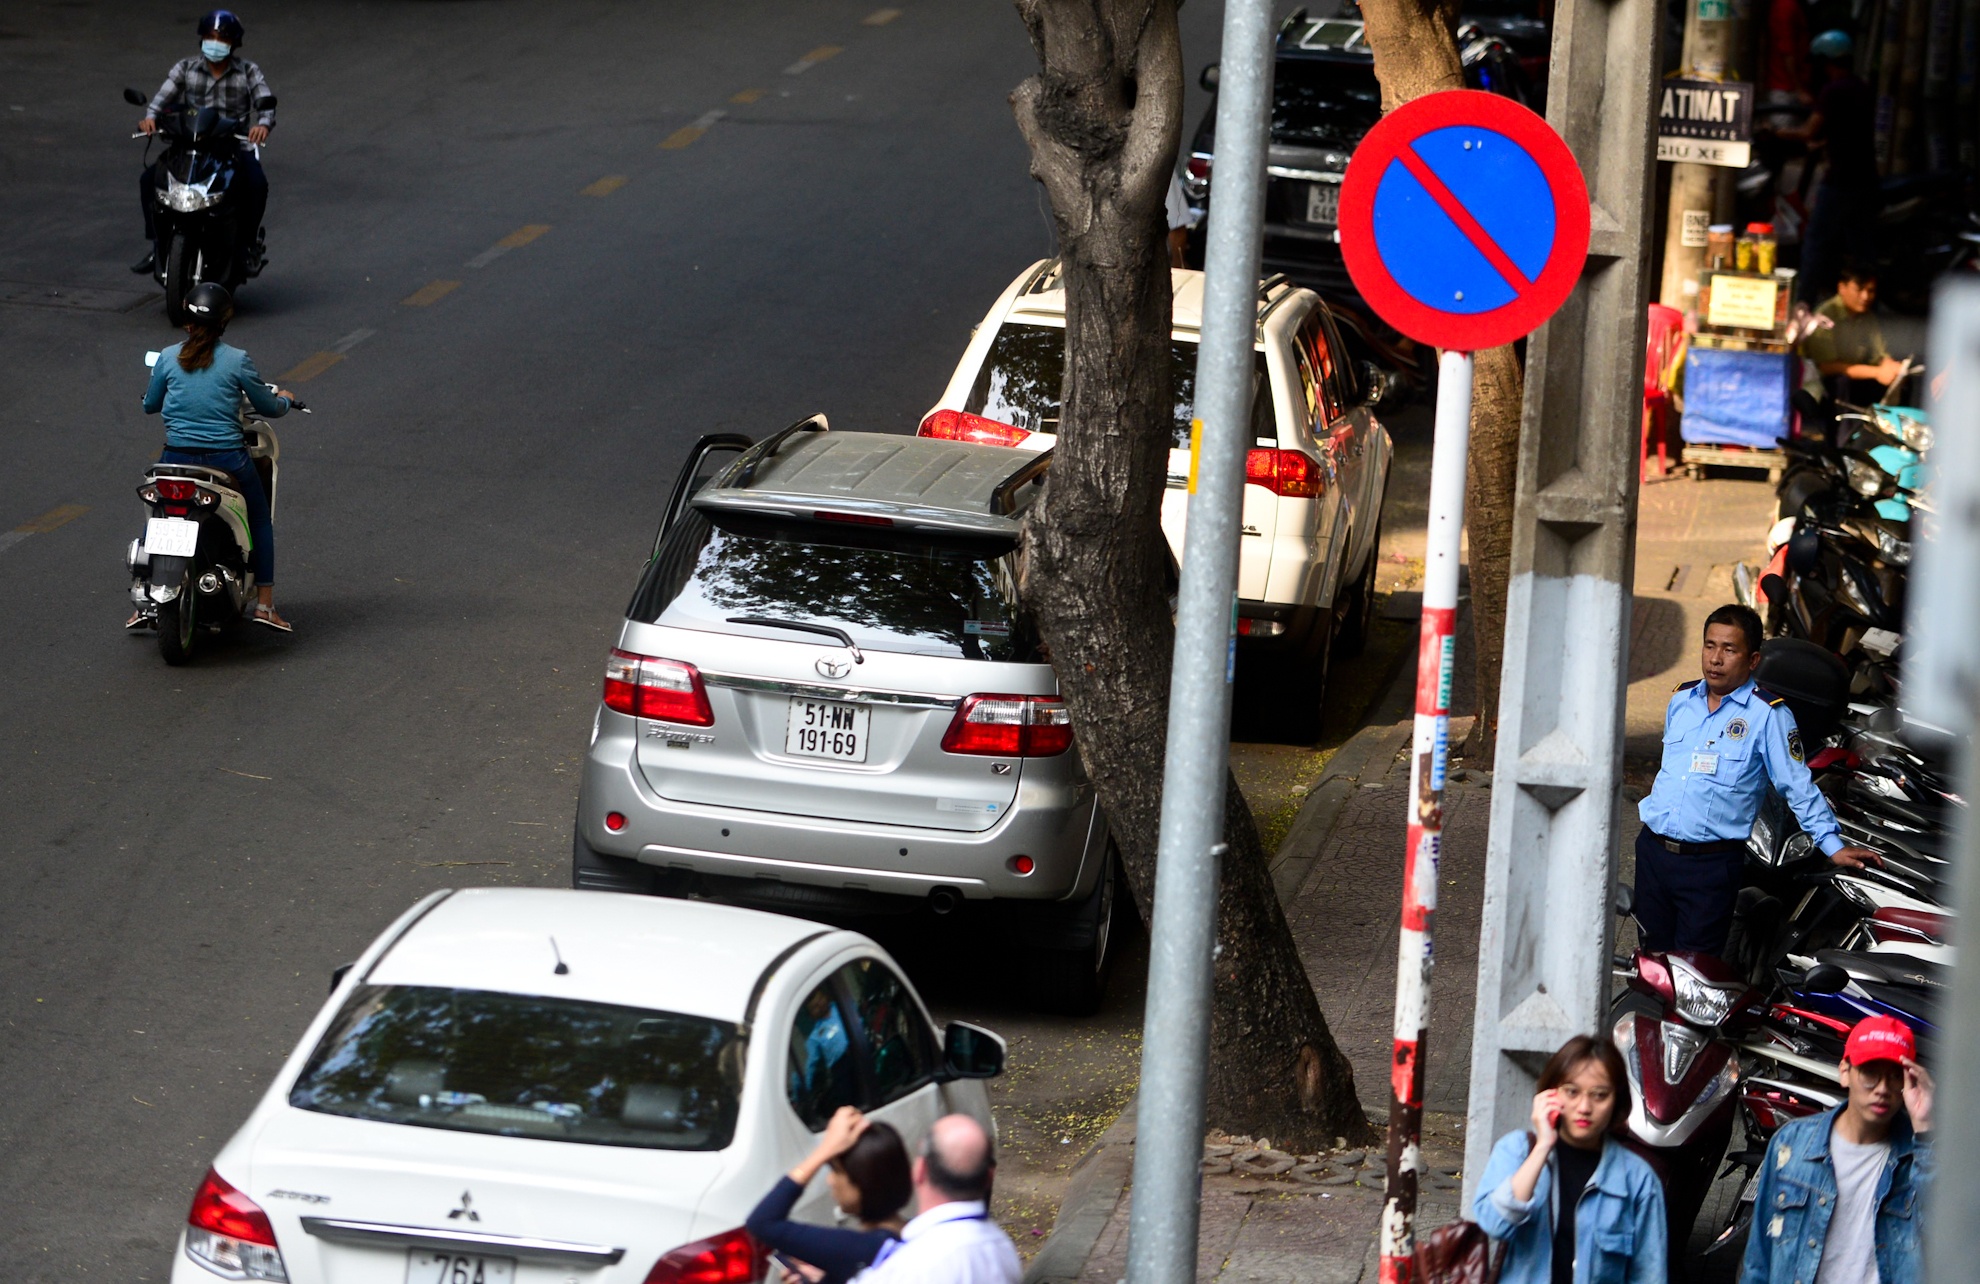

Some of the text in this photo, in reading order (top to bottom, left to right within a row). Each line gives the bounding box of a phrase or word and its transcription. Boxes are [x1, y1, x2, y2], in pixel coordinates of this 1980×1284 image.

[1660, 86, 1741, 123] ATINAT
[1698, 148, 1726, 161] XE
[798, 728, 857, 756] 191-69
[433, 1253, 486, 1284] 76A
